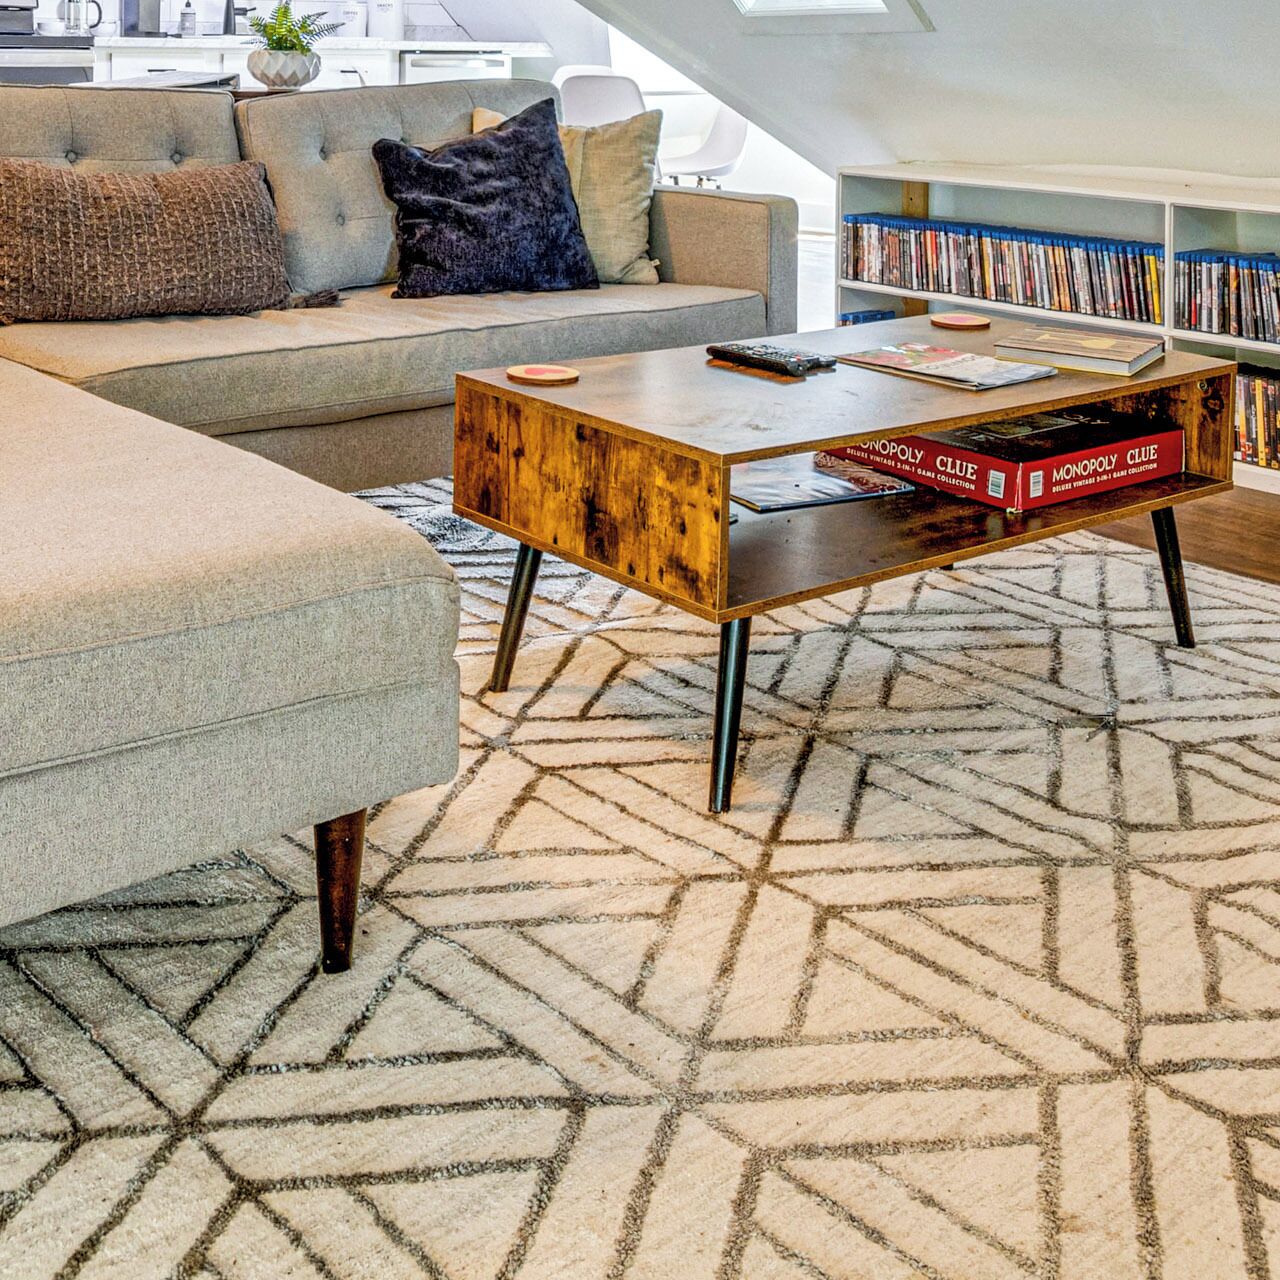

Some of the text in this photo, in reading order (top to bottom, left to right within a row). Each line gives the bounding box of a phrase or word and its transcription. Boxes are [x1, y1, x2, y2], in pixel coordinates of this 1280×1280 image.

[847, 448, 975, 490] DELUXE VINTAGE 2-IN-1 GAME COLLECTION
[857, 440, 978, 480] ONOPOLY CLUE
[1052, 445, 1158, 482] MONOPOLY CLUE
[1052, 484, 1071, 493] DELUXE
[1073, 478, 1095, 488] VINTAGE
[1097, 474, 1111, 482] 2-IN-1
[1128, 463, 1157, 474] COLLECTION
